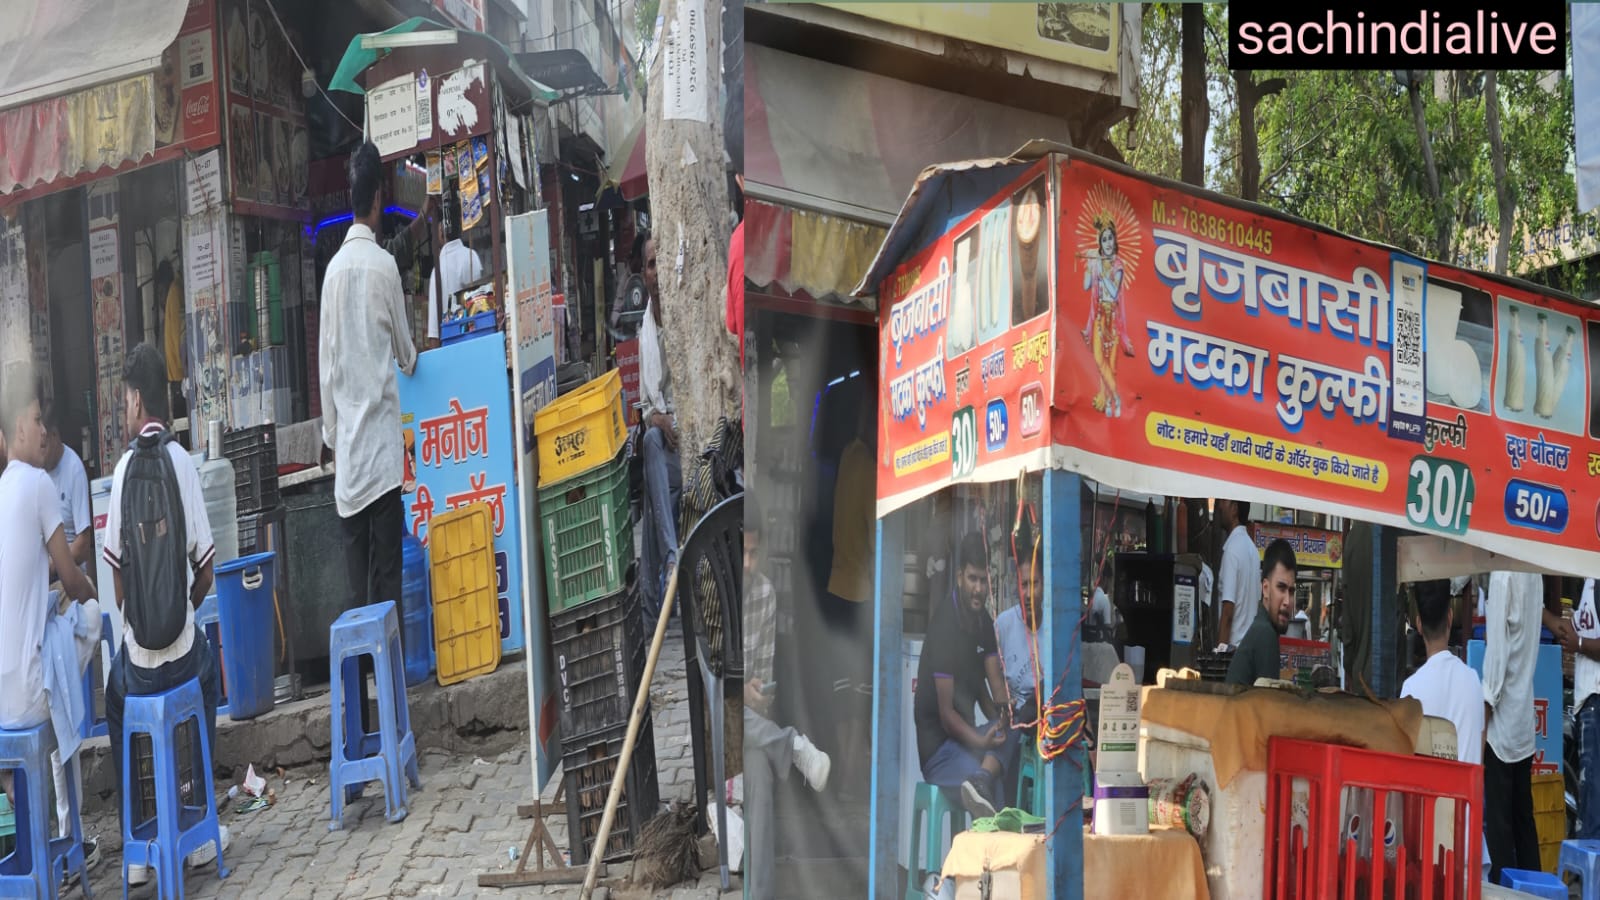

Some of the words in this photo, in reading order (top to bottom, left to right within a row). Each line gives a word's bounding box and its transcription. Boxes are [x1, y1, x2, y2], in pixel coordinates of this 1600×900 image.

[1181, 206, 1273, 255] 7838610445
[1152, 228, 1391, 346] बृजबासी
[1146, 320, 1270, 397] मटका
[1275, 355, 1391, 431] कुल्फी
[419, 397, 489, 468] मनोज
[988, 408, 1006, 443] 50/-
[1156, 419, 1175, 440] नोट
[1184, 428, 1207, 447] हमारे
[1210, 433, 1230, 452] यहाँ
[1231, 437, 1252, 456] शादी
[1255, 440, 1274, 460] पार्टी
[1275, 446, 1285, 463] के
[1287, 448, 1311, 469] ऑर्डर
[1312, 457, 1329, 476] बुक
[1330, 456, 1350, 475] किये
[1351, 463, 1370, 481] जाते
[1371, 465, 1379, 484] है
[1425, 413, 1468, 452] कुल्फी
[1505, 434, 1528, 469] दूध
[1529, 432, 1571, 471] बोतल
[1407, 459, 1473, 530] 30/-
[1515, 488, 1557, 523] 50/-
